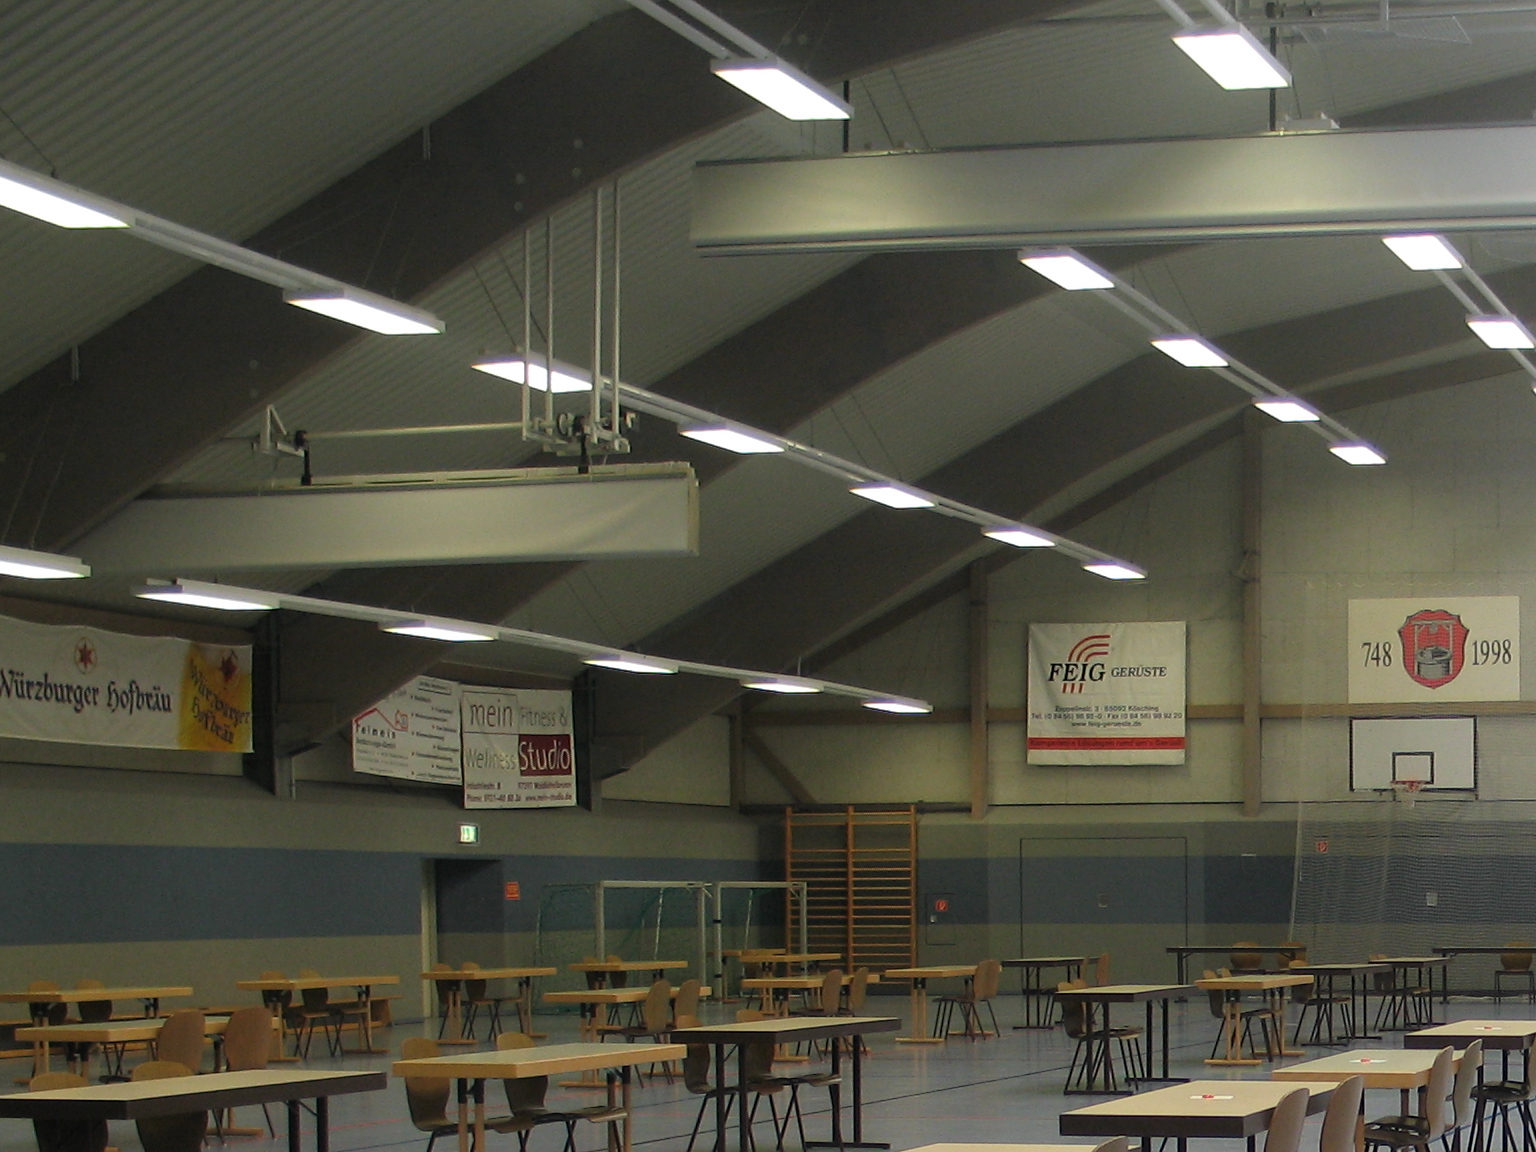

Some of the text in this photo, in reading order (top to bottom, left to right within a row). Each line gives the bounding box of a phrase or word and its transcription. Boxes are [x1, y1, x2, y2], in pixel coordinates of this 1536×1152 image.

[1361, 641, 1392, 669] 748
[1471, 639, 1513, 667] 1998
[1048, 662, 1168, 682] FEIG GERÜSTE
[106, 679, 173, 716] Hofbräu
[190, 658, 251, 728] Würzburger
[192, 696, 235, 745] Hofbräu
[469, 698, 513, 727] mein
[520, 705, 568, 727] Fitness &
[465, 748, 516, 770] Wellness
[519, 740, 571, 771] Studio
